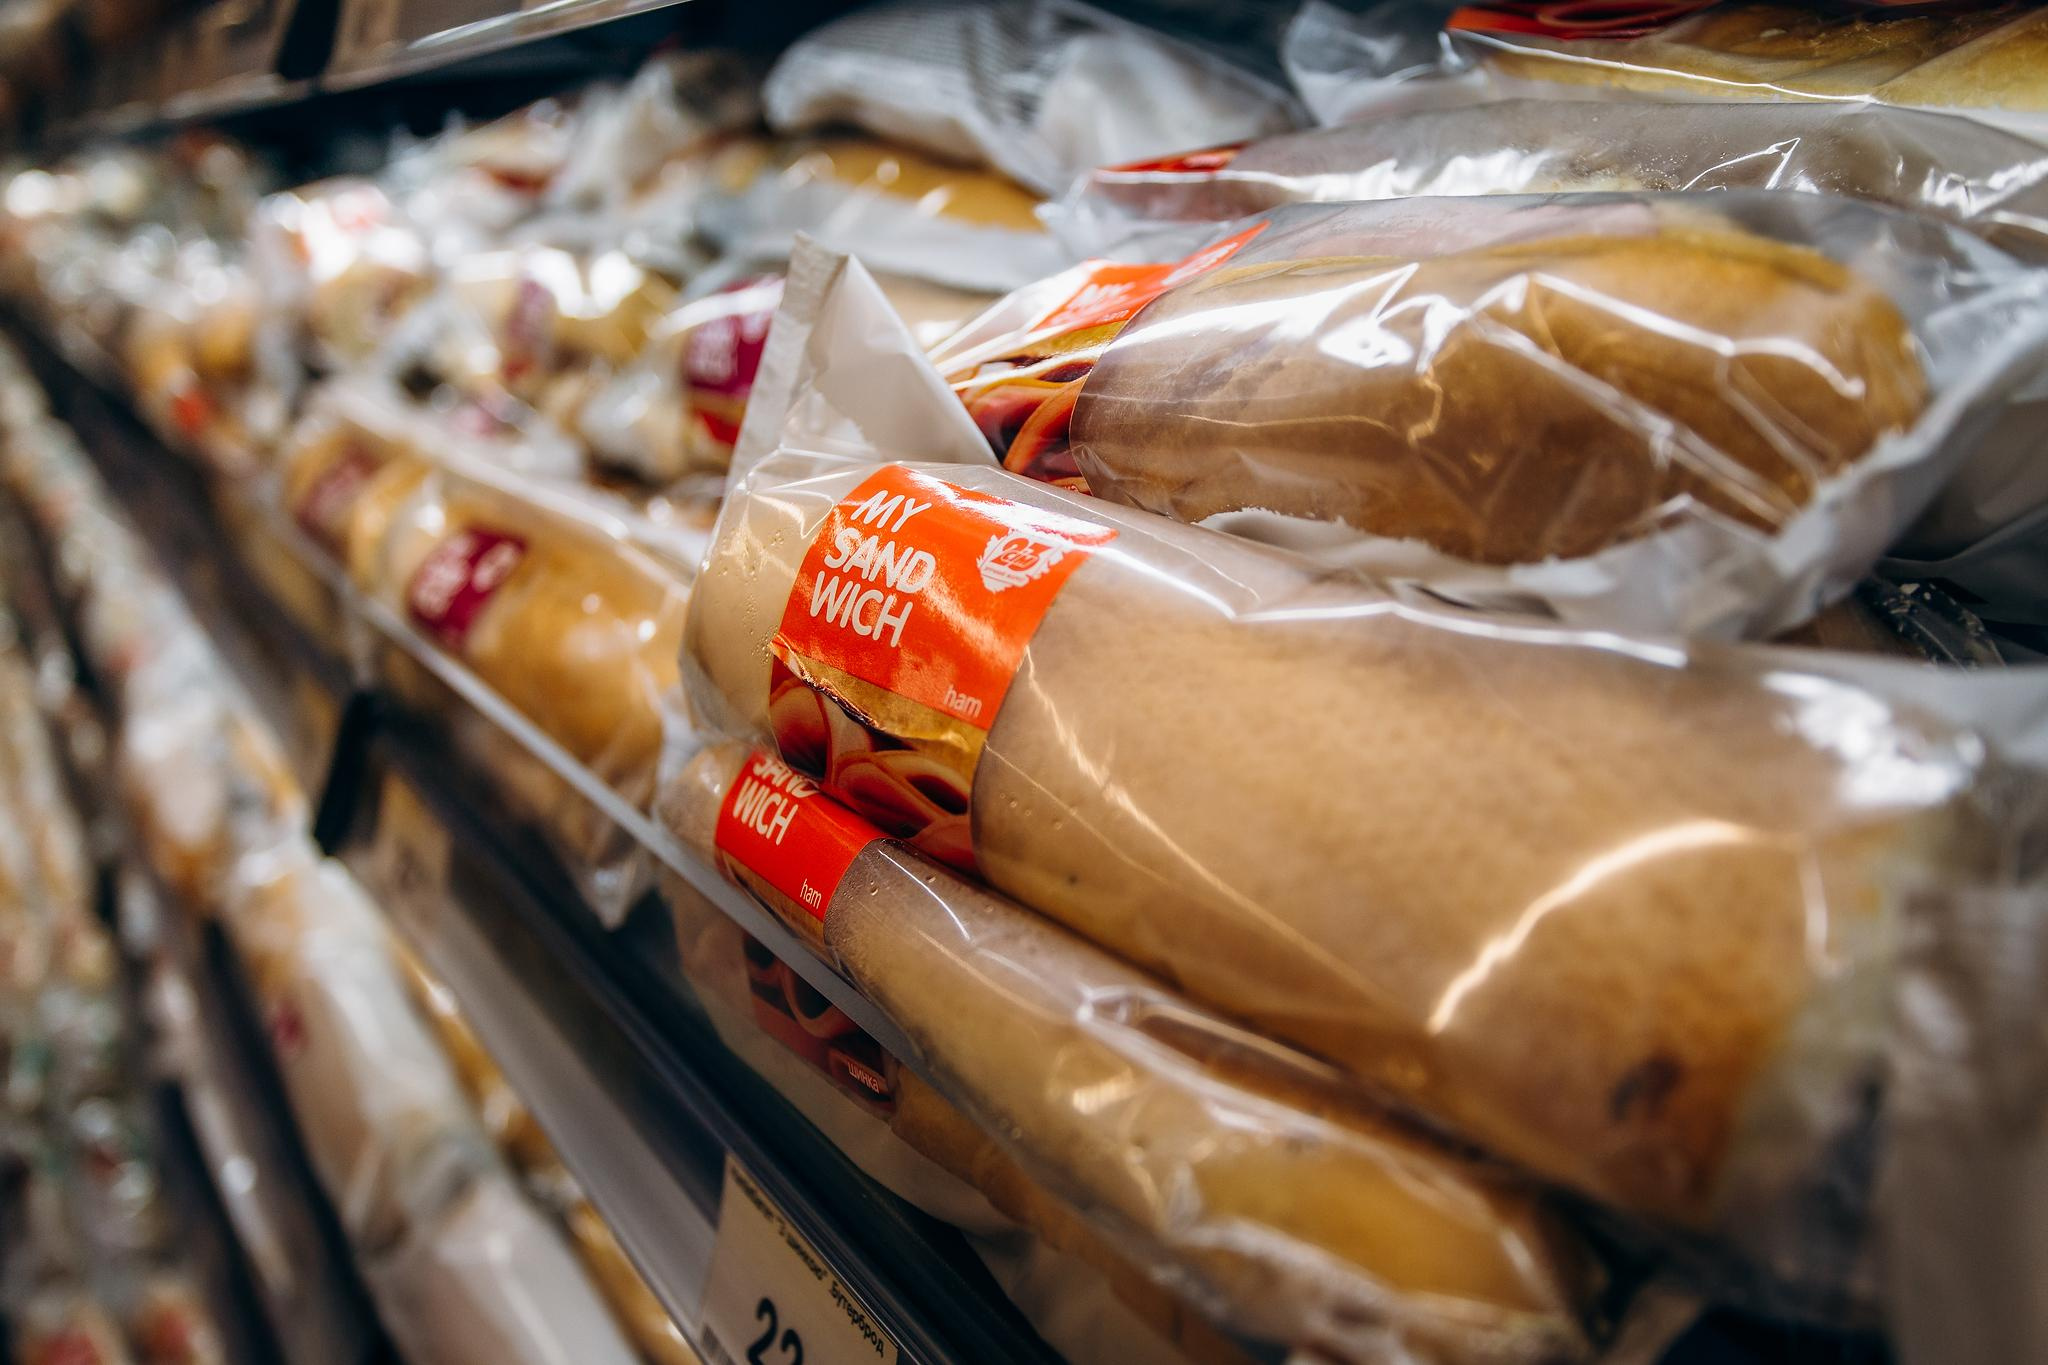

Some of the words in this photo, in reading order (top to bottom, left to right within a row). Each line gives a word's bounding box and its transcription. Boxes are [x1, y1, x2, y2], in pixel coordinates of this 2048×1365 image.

[850, 489, 932, 533] MY
[824, 528, 937, 594] SAND
[809, 571, 914, 648] WICH
[943, 684, 983, 718] ham
[732, 776, 799, 846] WICH
[800, 878, 822, 910] ham
